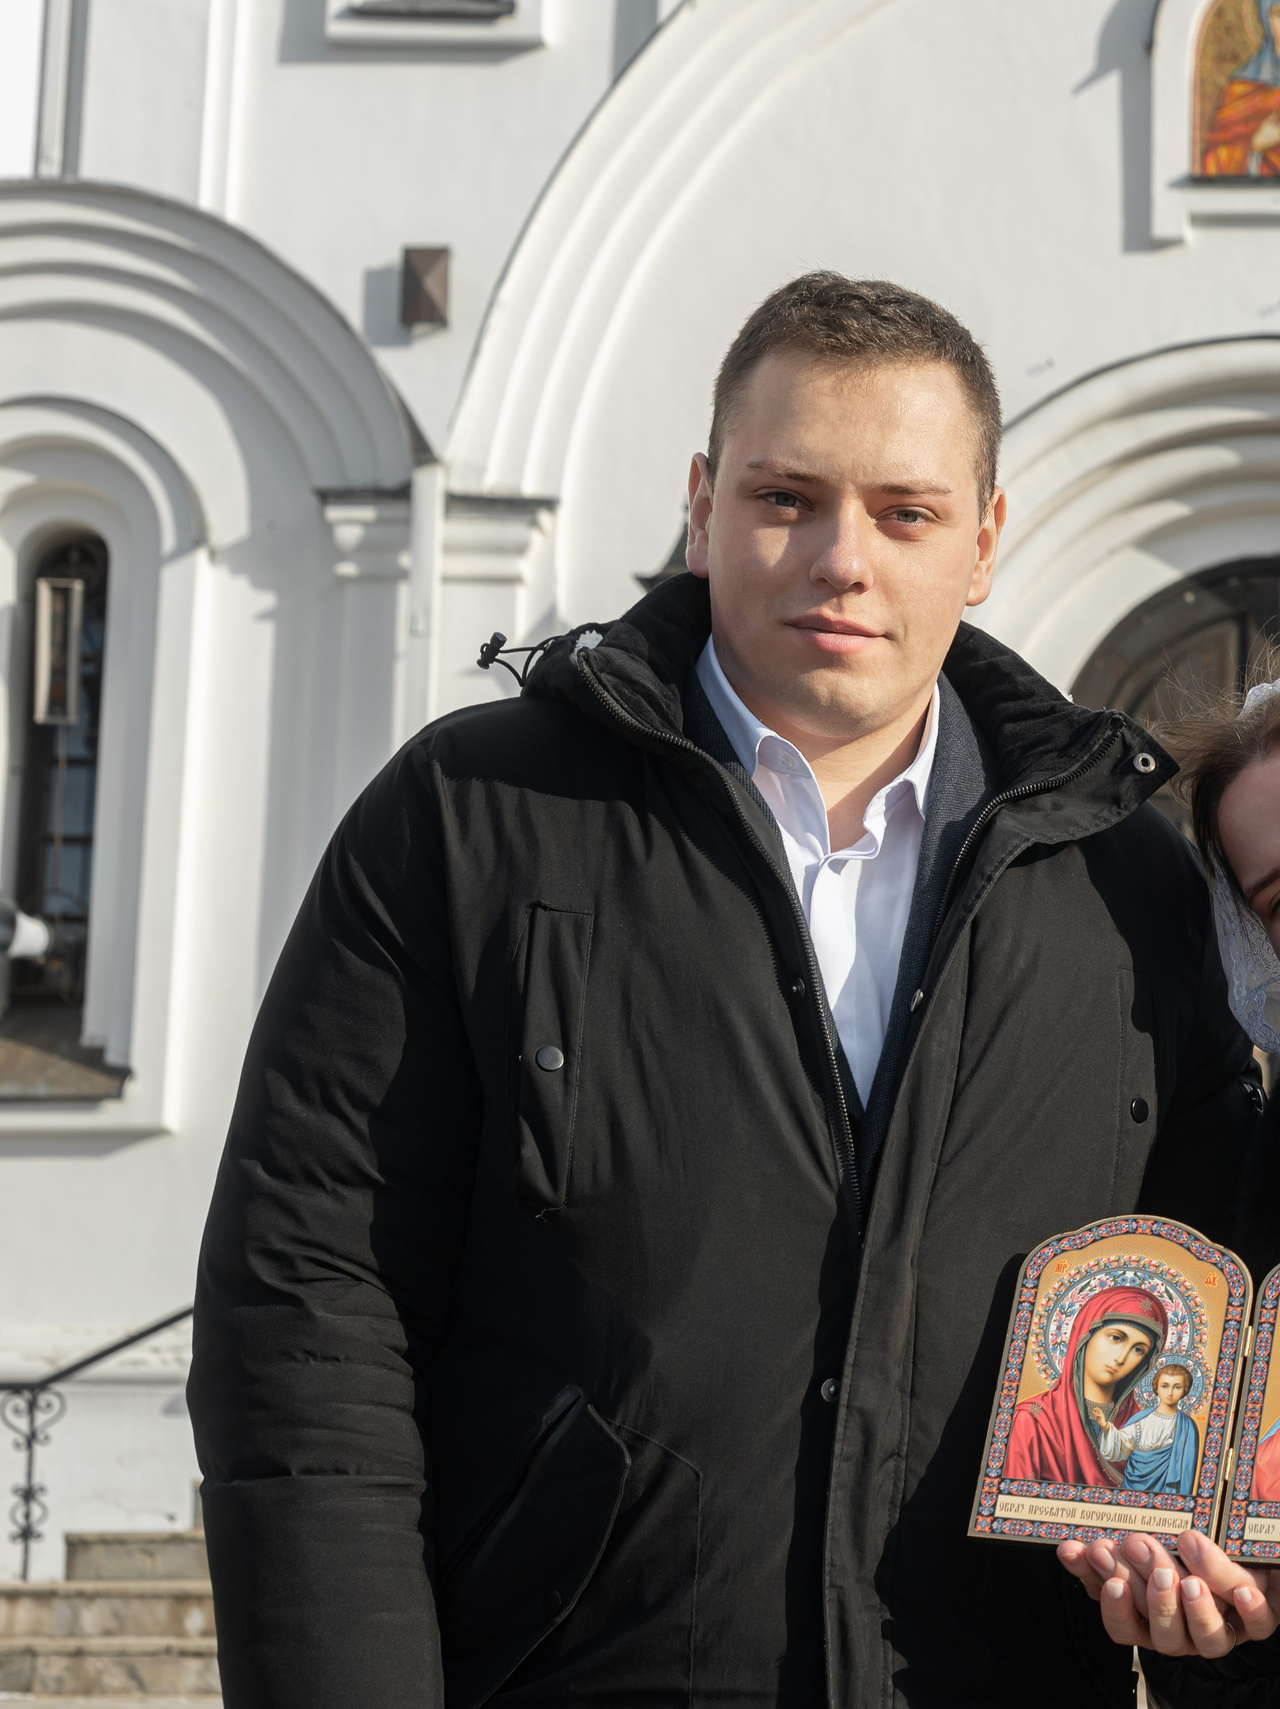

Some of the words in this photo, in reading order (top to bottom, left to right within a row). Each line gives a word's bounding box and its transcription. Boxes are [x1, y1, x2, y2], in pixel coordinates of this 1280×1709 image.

[998, 1501, 1025, 1514] ОБРАЗ
[1028, 1504, 1077, 1519] ПРЕСВЯТОЙ
[1080, 1509, 1137, 1524] БОГОРОДИЦЫ
[1140, 1514, 1189, 1530] КАЗАНСКАЯ
[1248, 1522, 1276, 1535] ОБРАЗ
